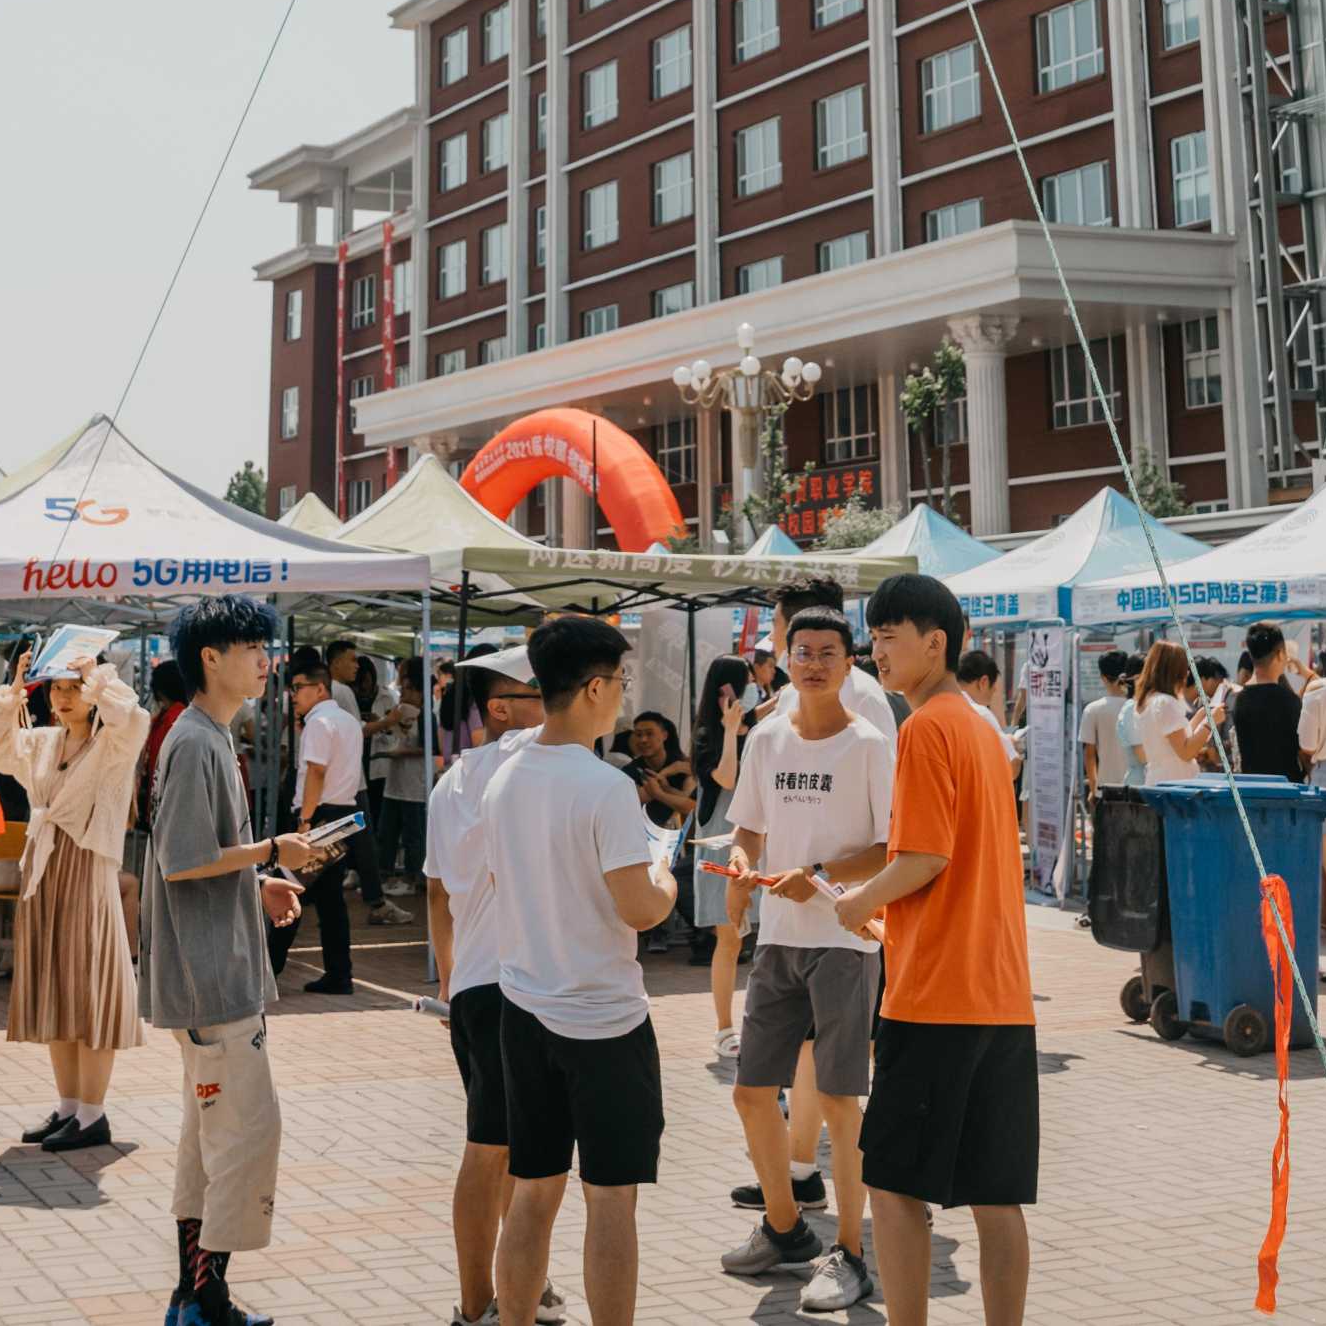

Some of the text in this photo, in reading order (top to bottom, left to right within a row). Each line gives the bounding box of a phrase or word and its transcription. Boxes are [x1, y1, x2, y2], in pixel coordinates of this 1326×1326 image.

[44, 497, 130, 526] 5G
[22, 557, 119, 592] hello
[1116, 580, 1289, 612] 中国移动5G网络已覆盖
[775, 772, 833, 793] 好看的皮囊
